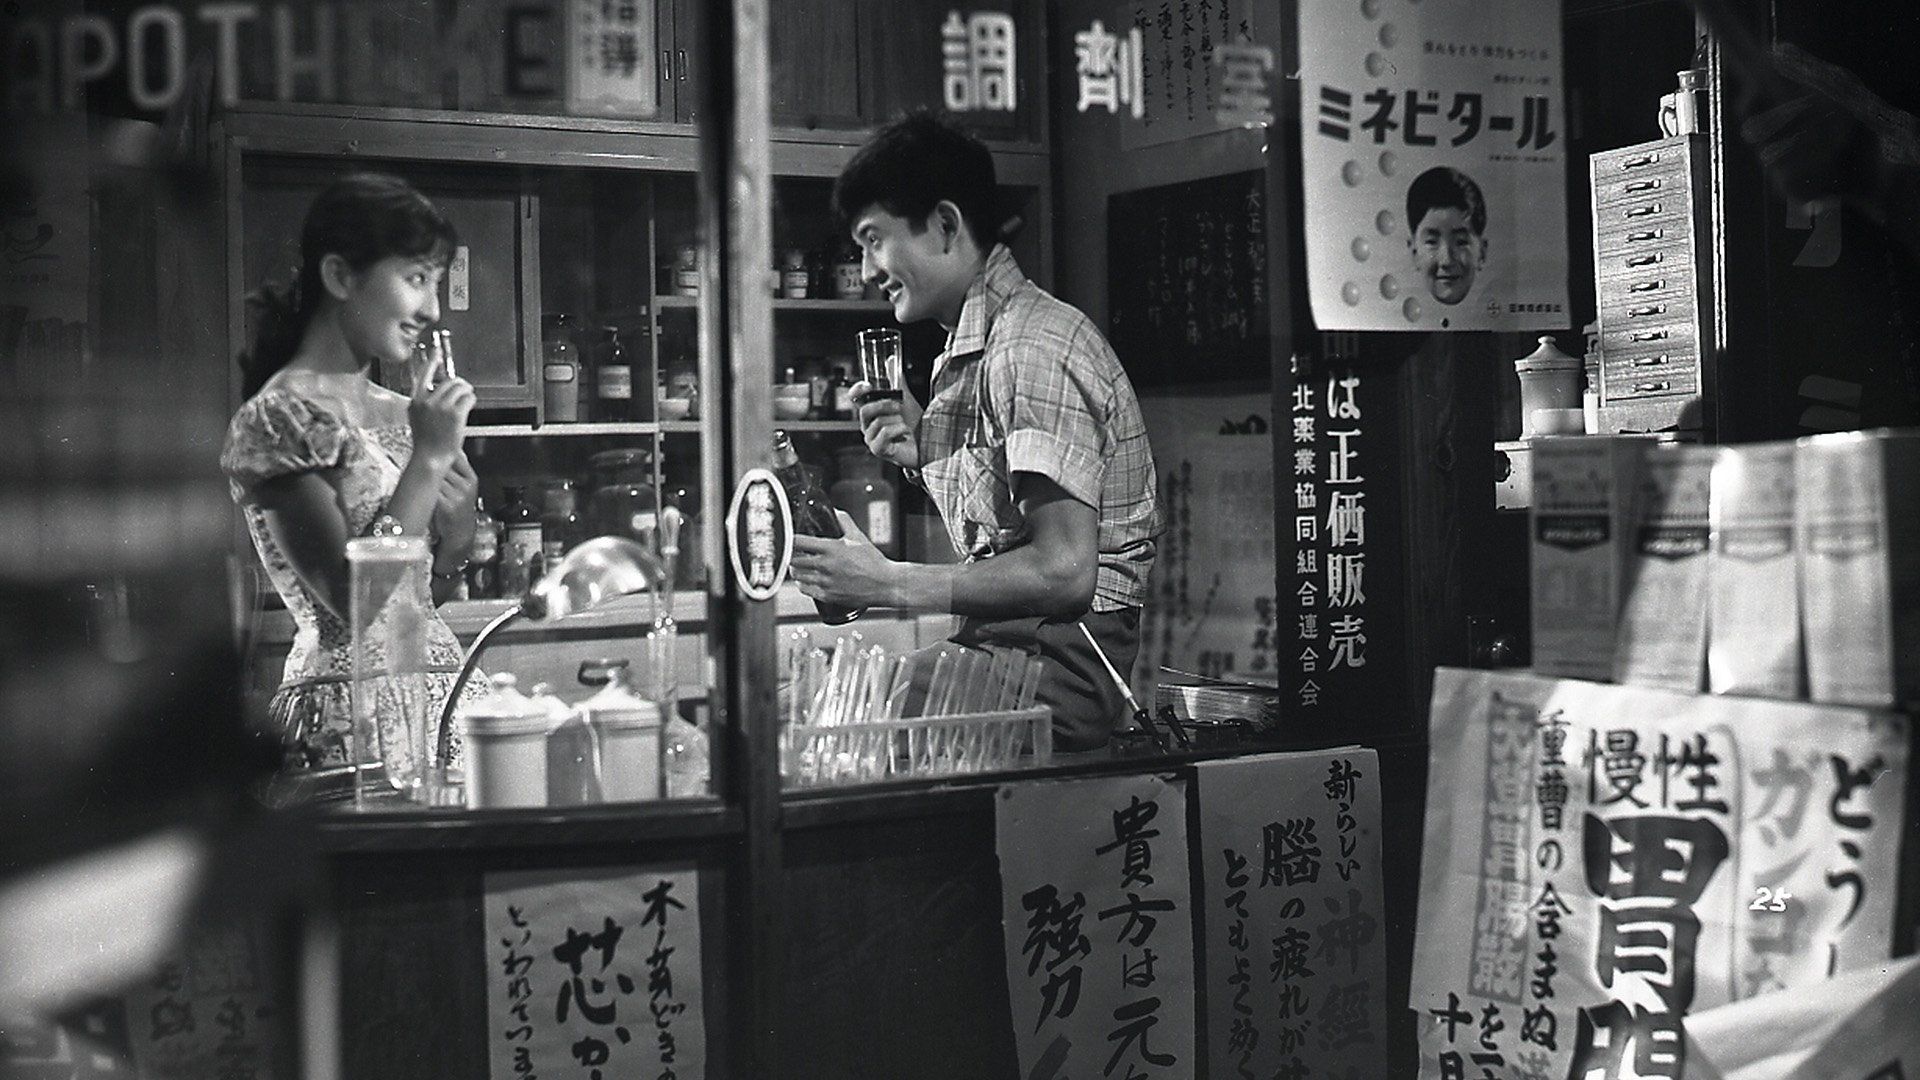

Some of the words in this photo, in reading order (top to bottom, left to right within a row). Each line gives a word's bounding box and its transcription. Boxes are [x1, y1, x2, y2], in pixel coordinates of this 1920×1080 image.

[10, 4, 556, 110] APOTHE
[1318, 85, 1556, 150] ミネビタール
[502, 905, 537, 1080] といわれてつま
[553, 916, 635, 1080] 芯か
[1095, 796, 1177, 1080] 貴方は元
